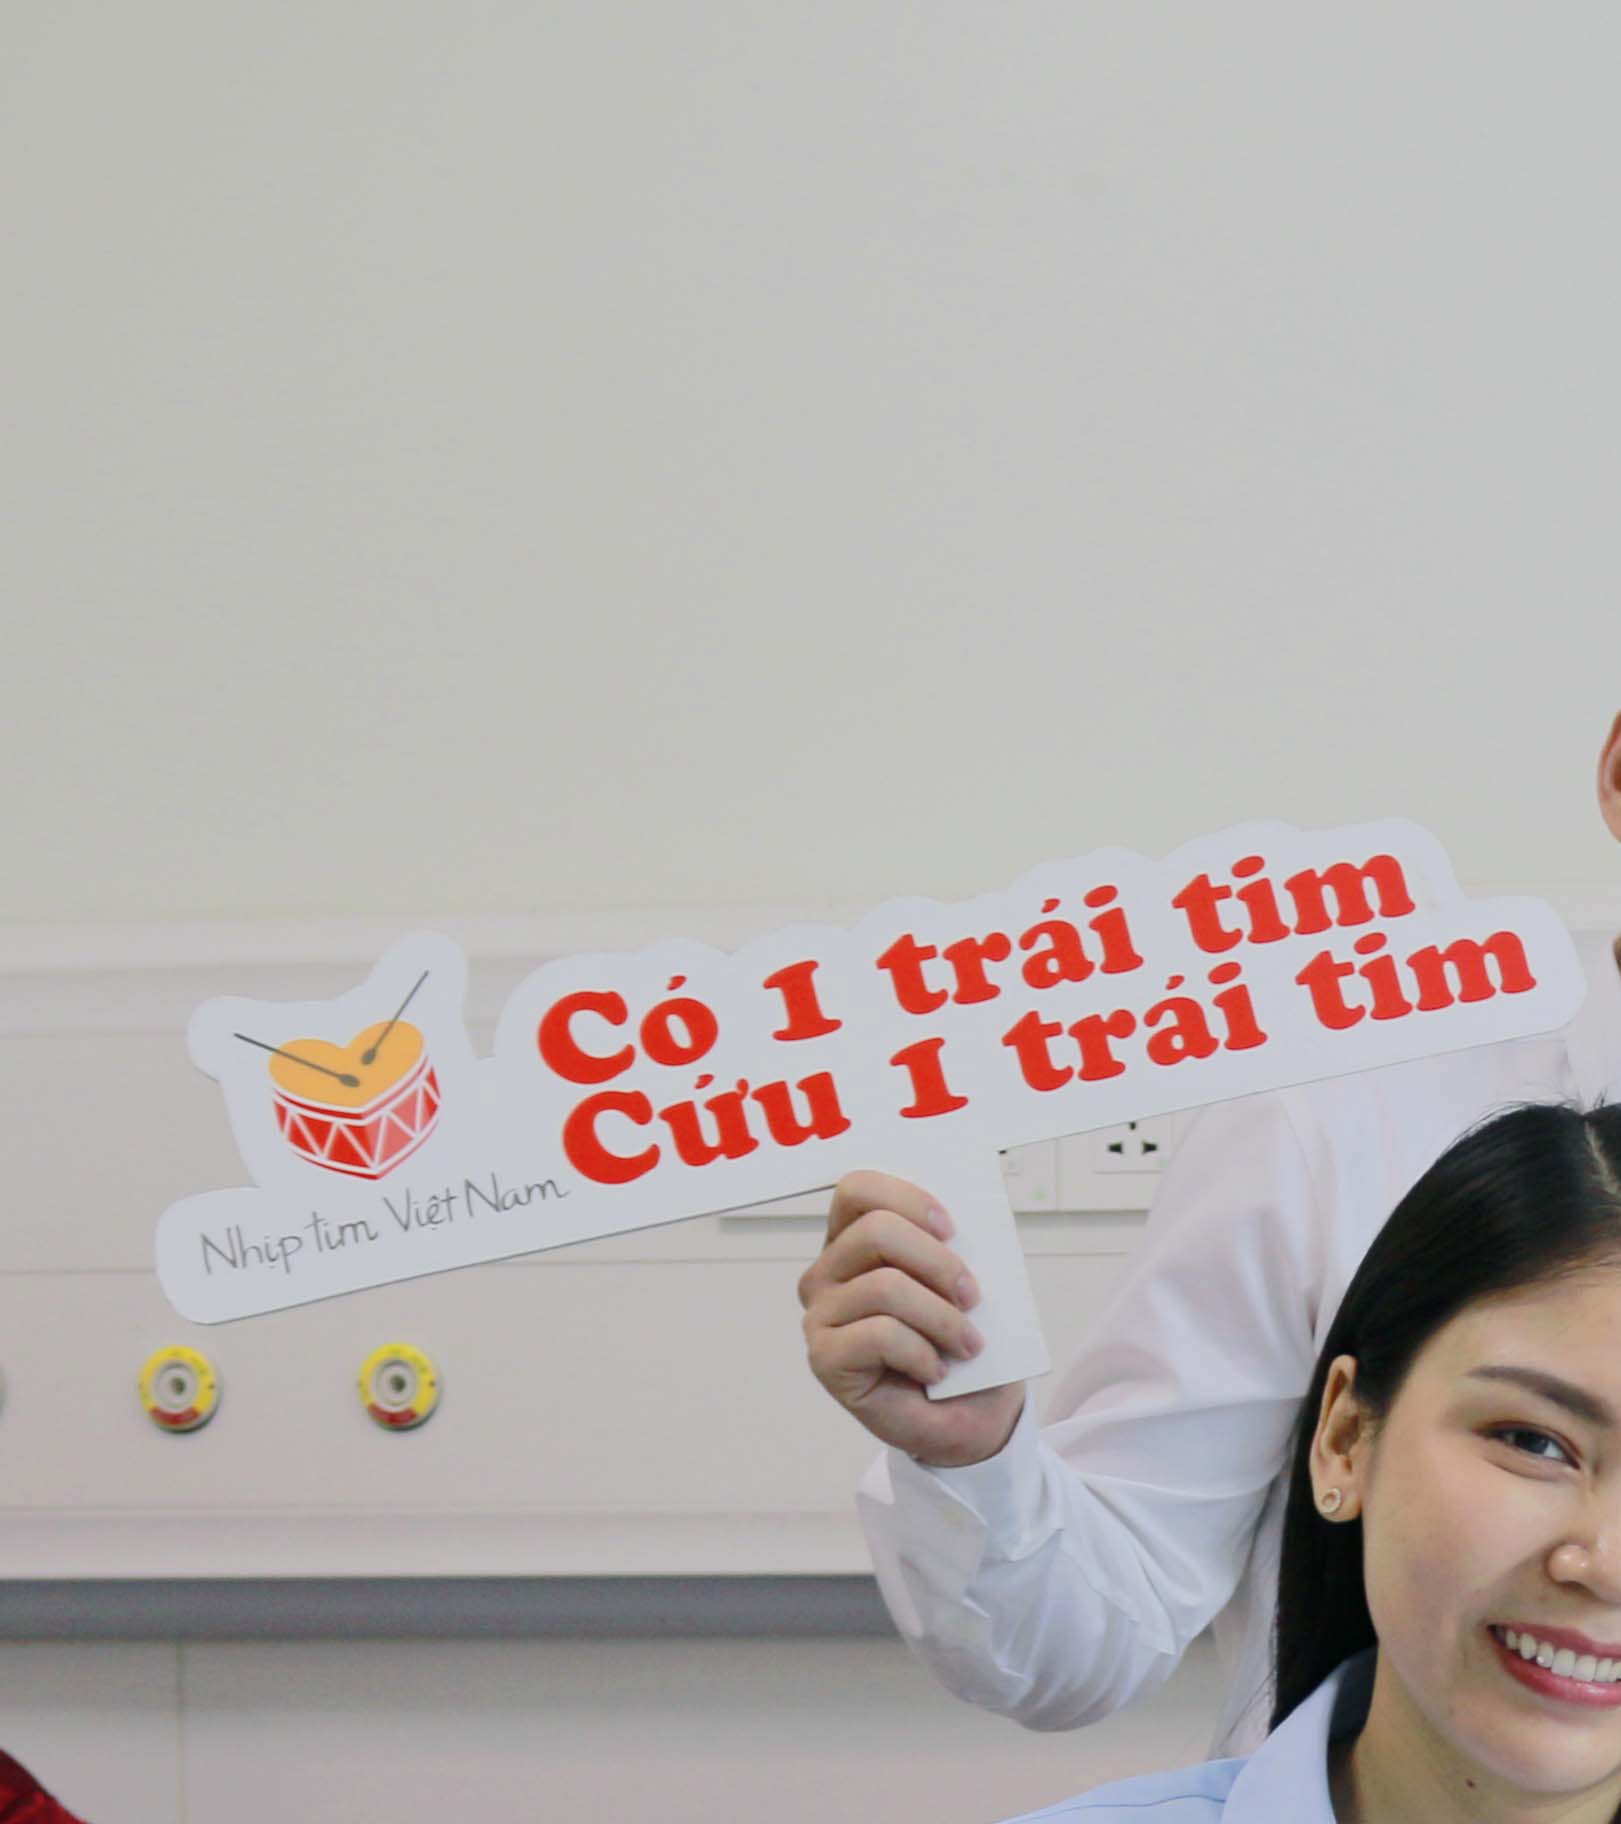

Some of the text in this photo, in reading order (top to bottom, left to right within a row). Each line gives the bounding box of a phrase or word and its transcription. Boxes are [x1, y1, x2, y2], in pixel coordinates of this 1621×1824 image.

[537, 974, 720, 1085] Có
[875, 884, 1144, 1016] trái
[1172, 852, 1417, 955] tim
[562, 1072, 851, 1186] Cứu
[1001, 961, 1269, 1093] trái
[1294, 929, 1538, 1031] tim
[200, 1171, 571, 1275] Nhịp tim Việt Nam
